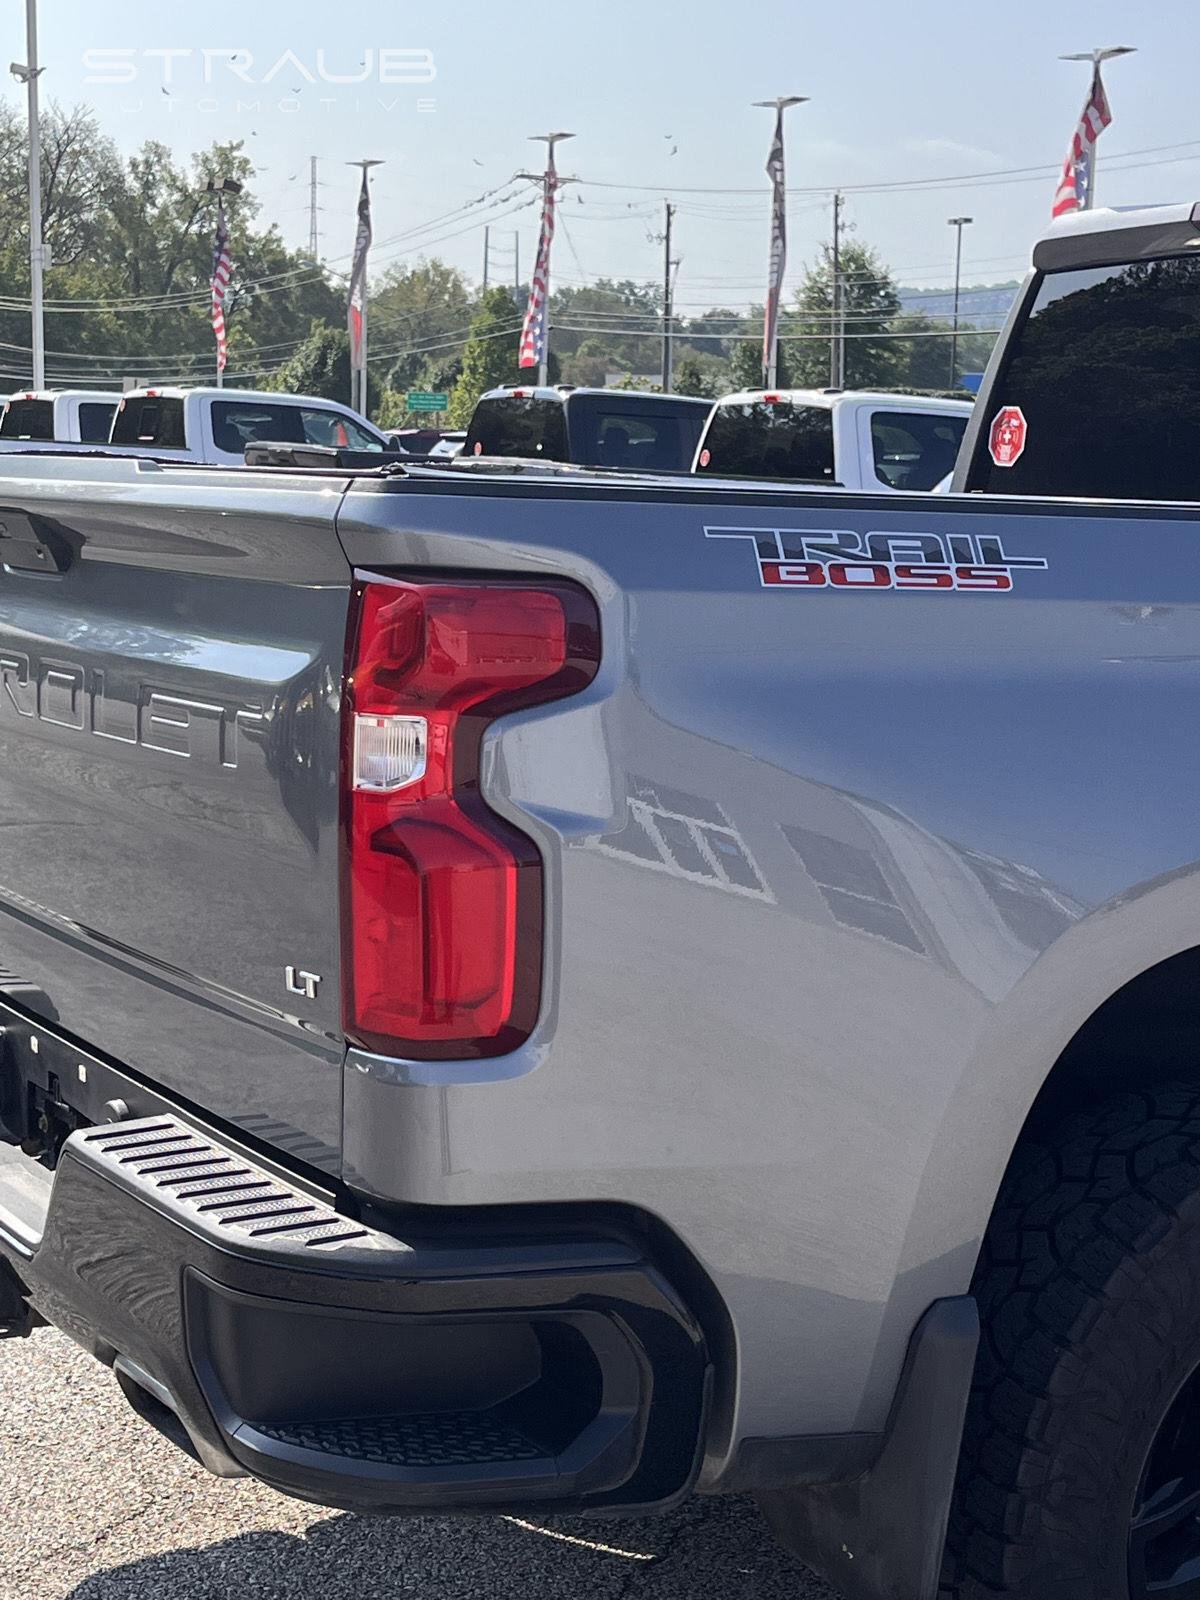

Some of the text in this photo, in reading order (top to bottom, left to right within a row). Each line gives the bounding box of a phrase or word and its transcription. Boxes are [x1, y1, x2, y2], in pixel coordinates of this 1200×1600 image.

[703, 526, 1048, 569] TRAIL
[757, 559, 1013, 592] BOSS
[284, 965, 322, 999] LT
